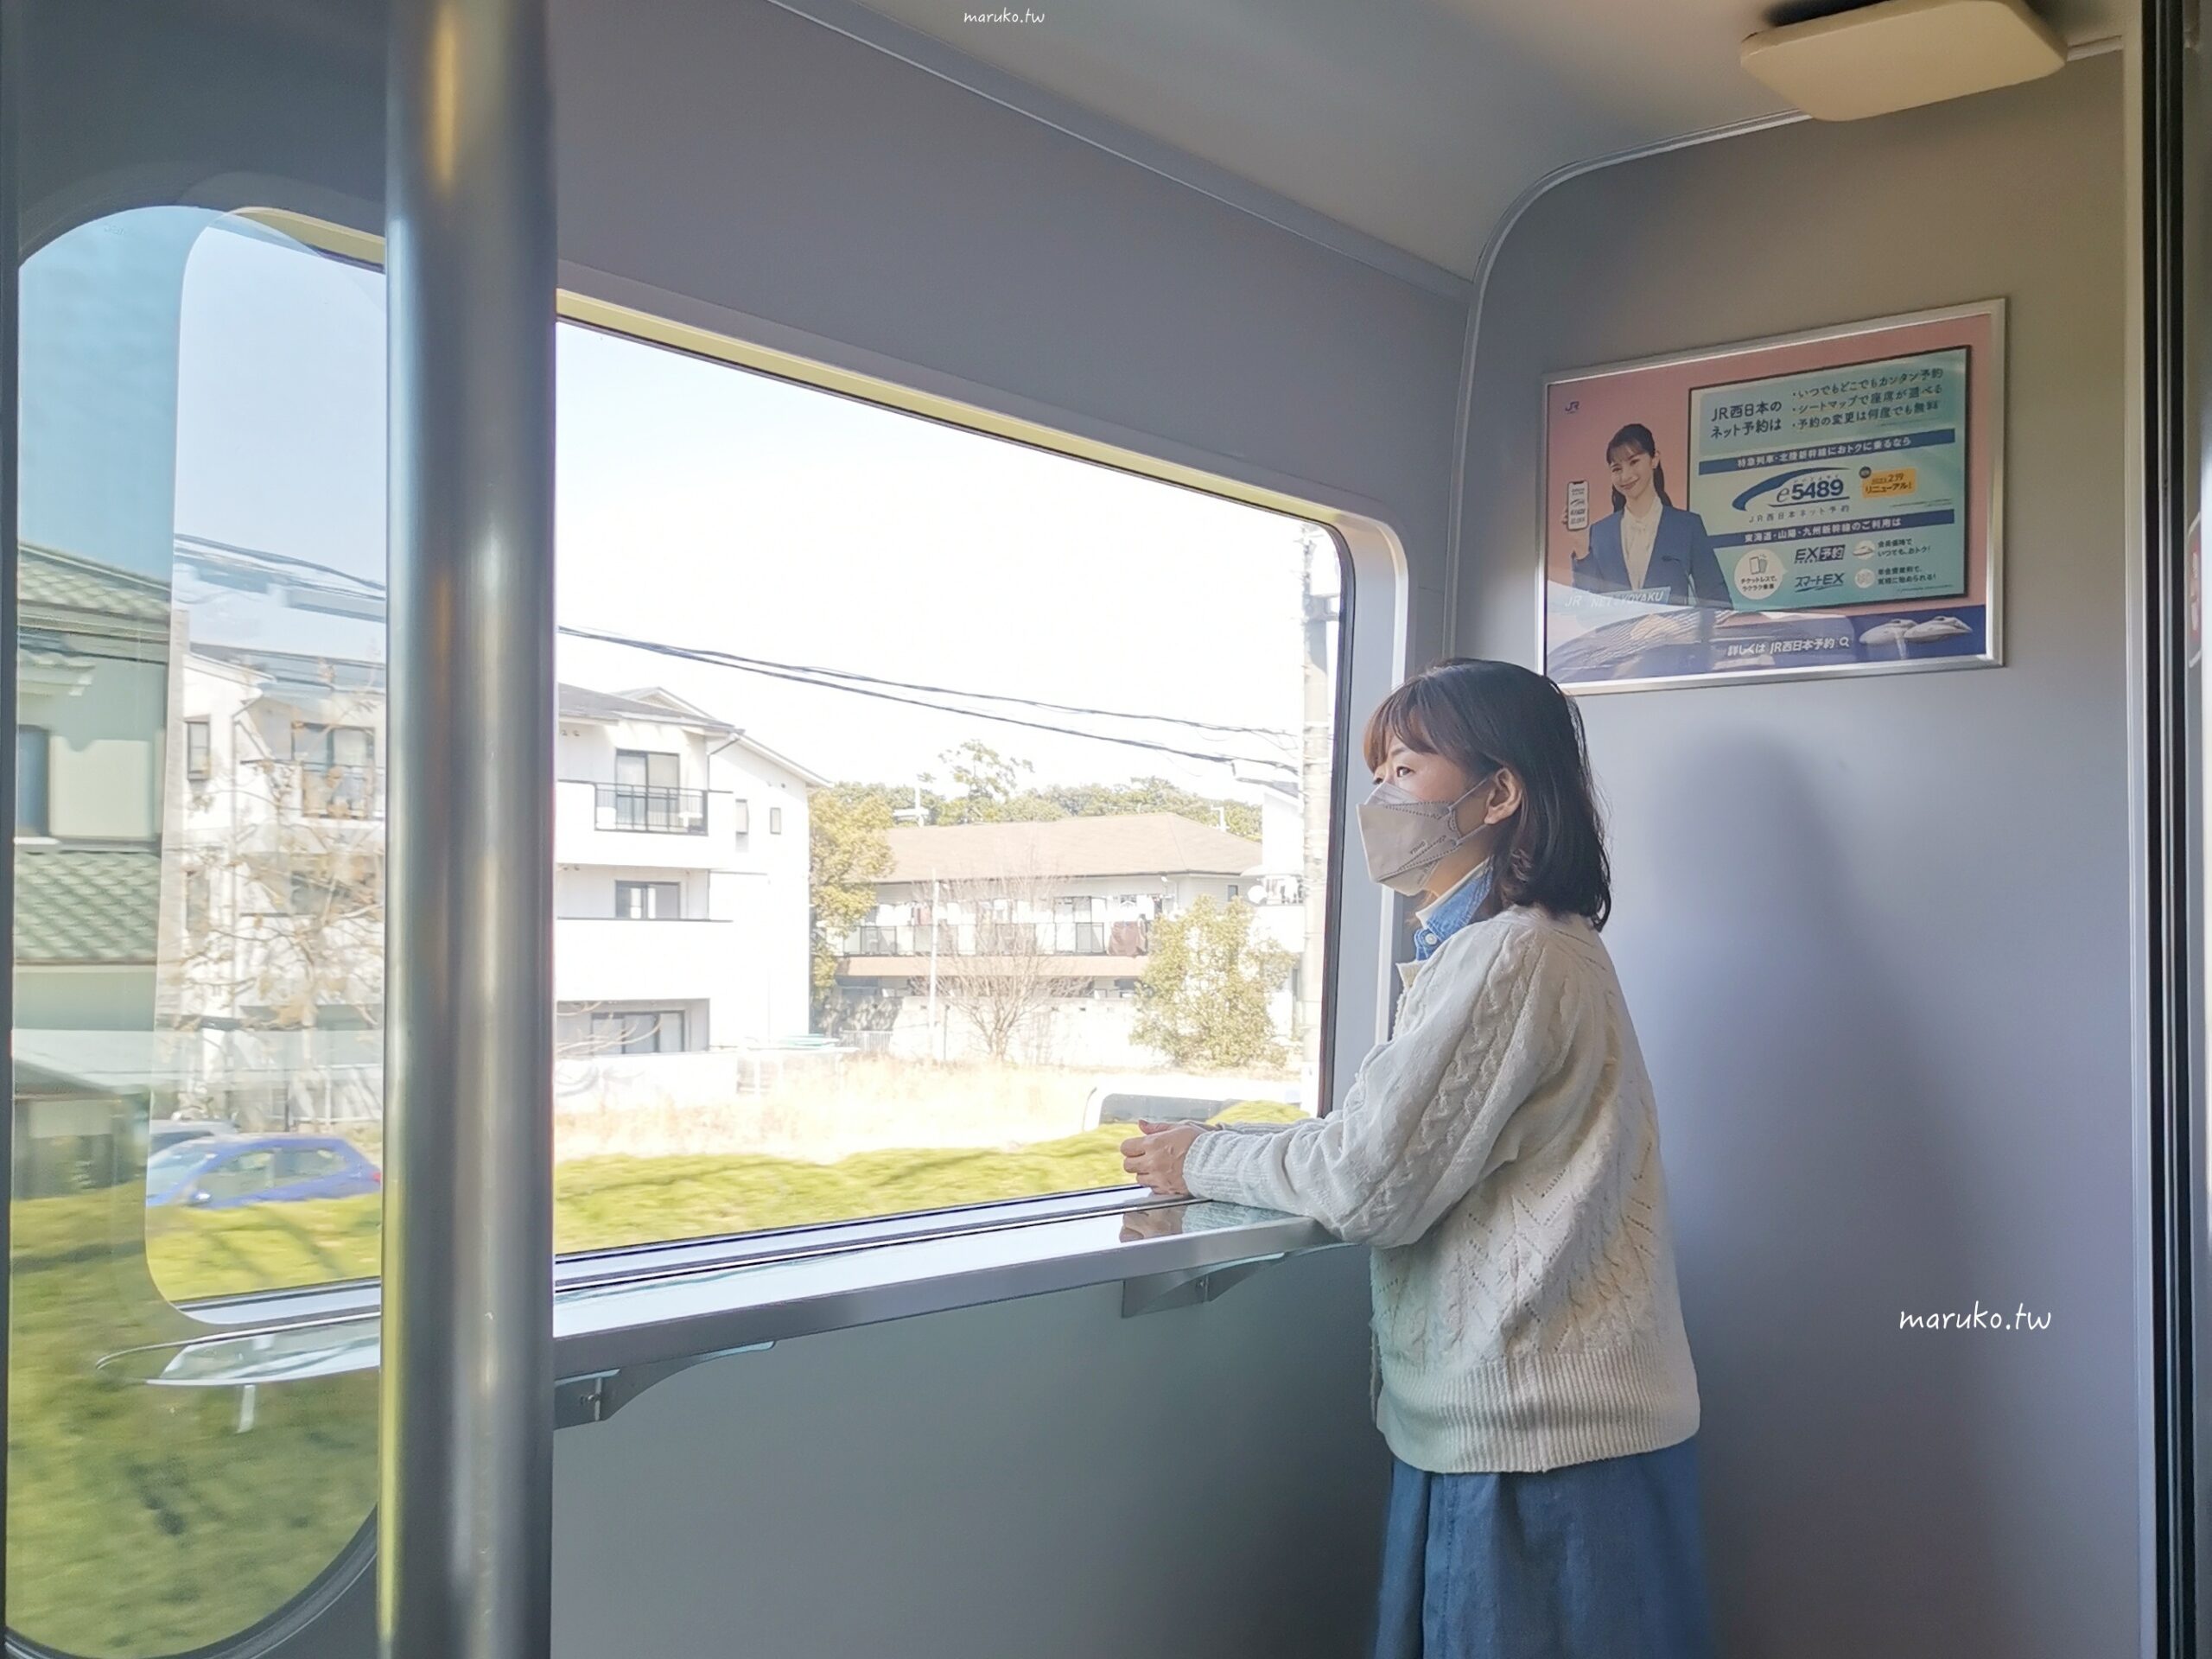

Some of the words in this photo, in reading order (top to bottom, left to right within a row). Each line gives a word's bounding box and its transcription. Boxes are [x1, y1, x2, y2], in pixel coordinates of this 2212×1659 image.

[1565, 401, 1580, 411] JR
[1711, 401, 1782, 422] JR西日本の
[1710, 418, 1782, 439] ネット予約は
[1776, 478, 1844, 503] e5489
[1795, 573, 1846, 588] スマートEX
[1727, 643, 1765, 657] 詳しくは
[1770, 638, 1835, 655] JR西日本予約
